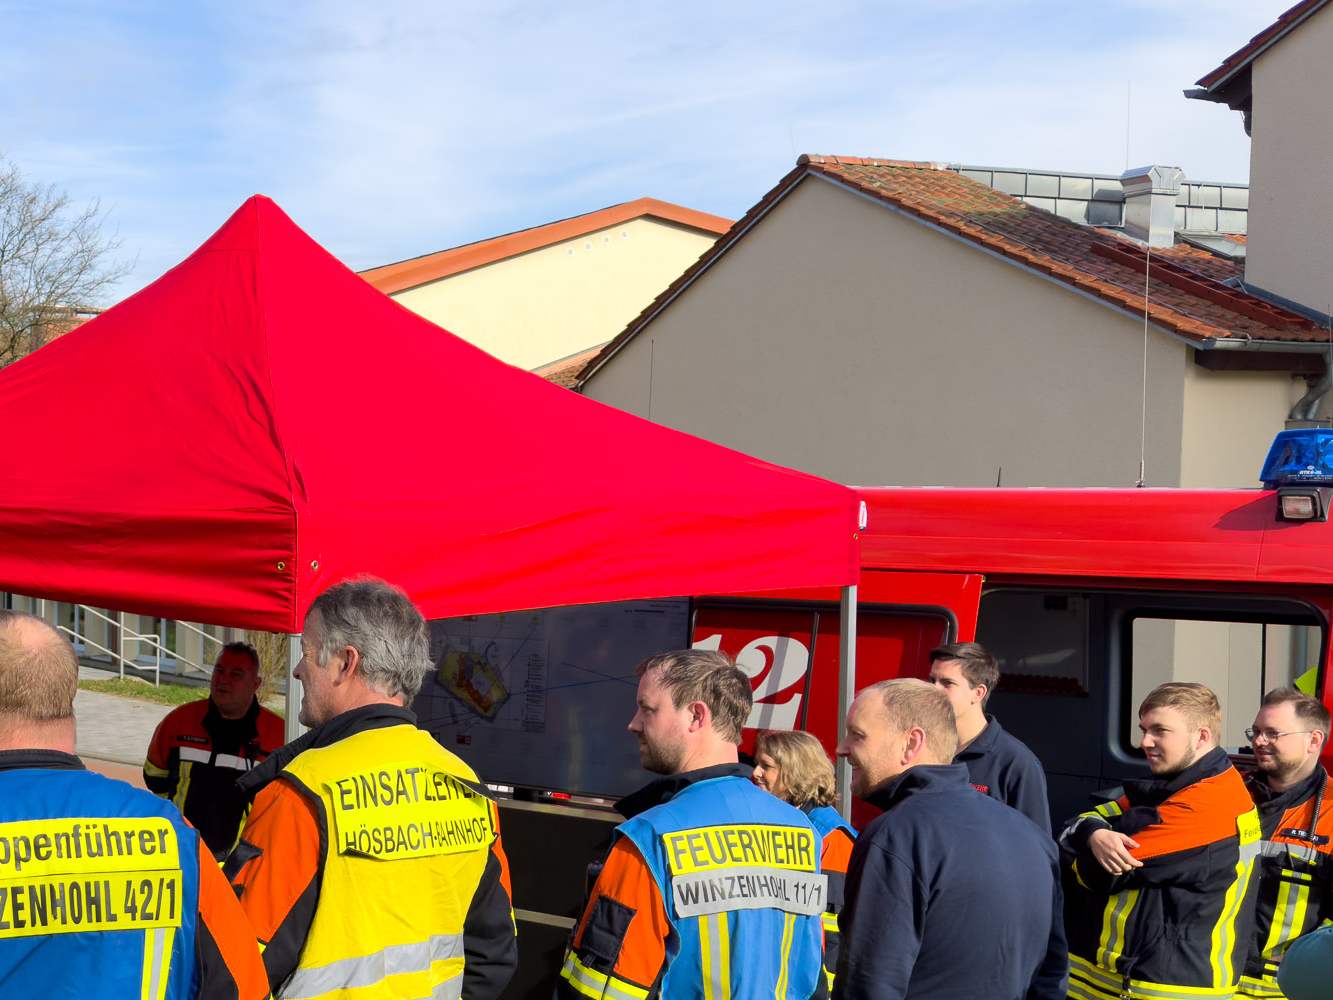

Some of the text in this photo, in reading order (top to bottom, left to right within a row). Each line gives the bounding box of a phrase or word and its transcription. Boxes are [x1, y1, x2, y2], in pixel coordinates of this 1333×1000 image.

[692, 634, 810, 731] 2
[670, 830, 813, 871] FEUERWEHR
[123, 878, 176, 922] 42/1
[676, 875, 823, 907] WINZENHOHL 11/1
